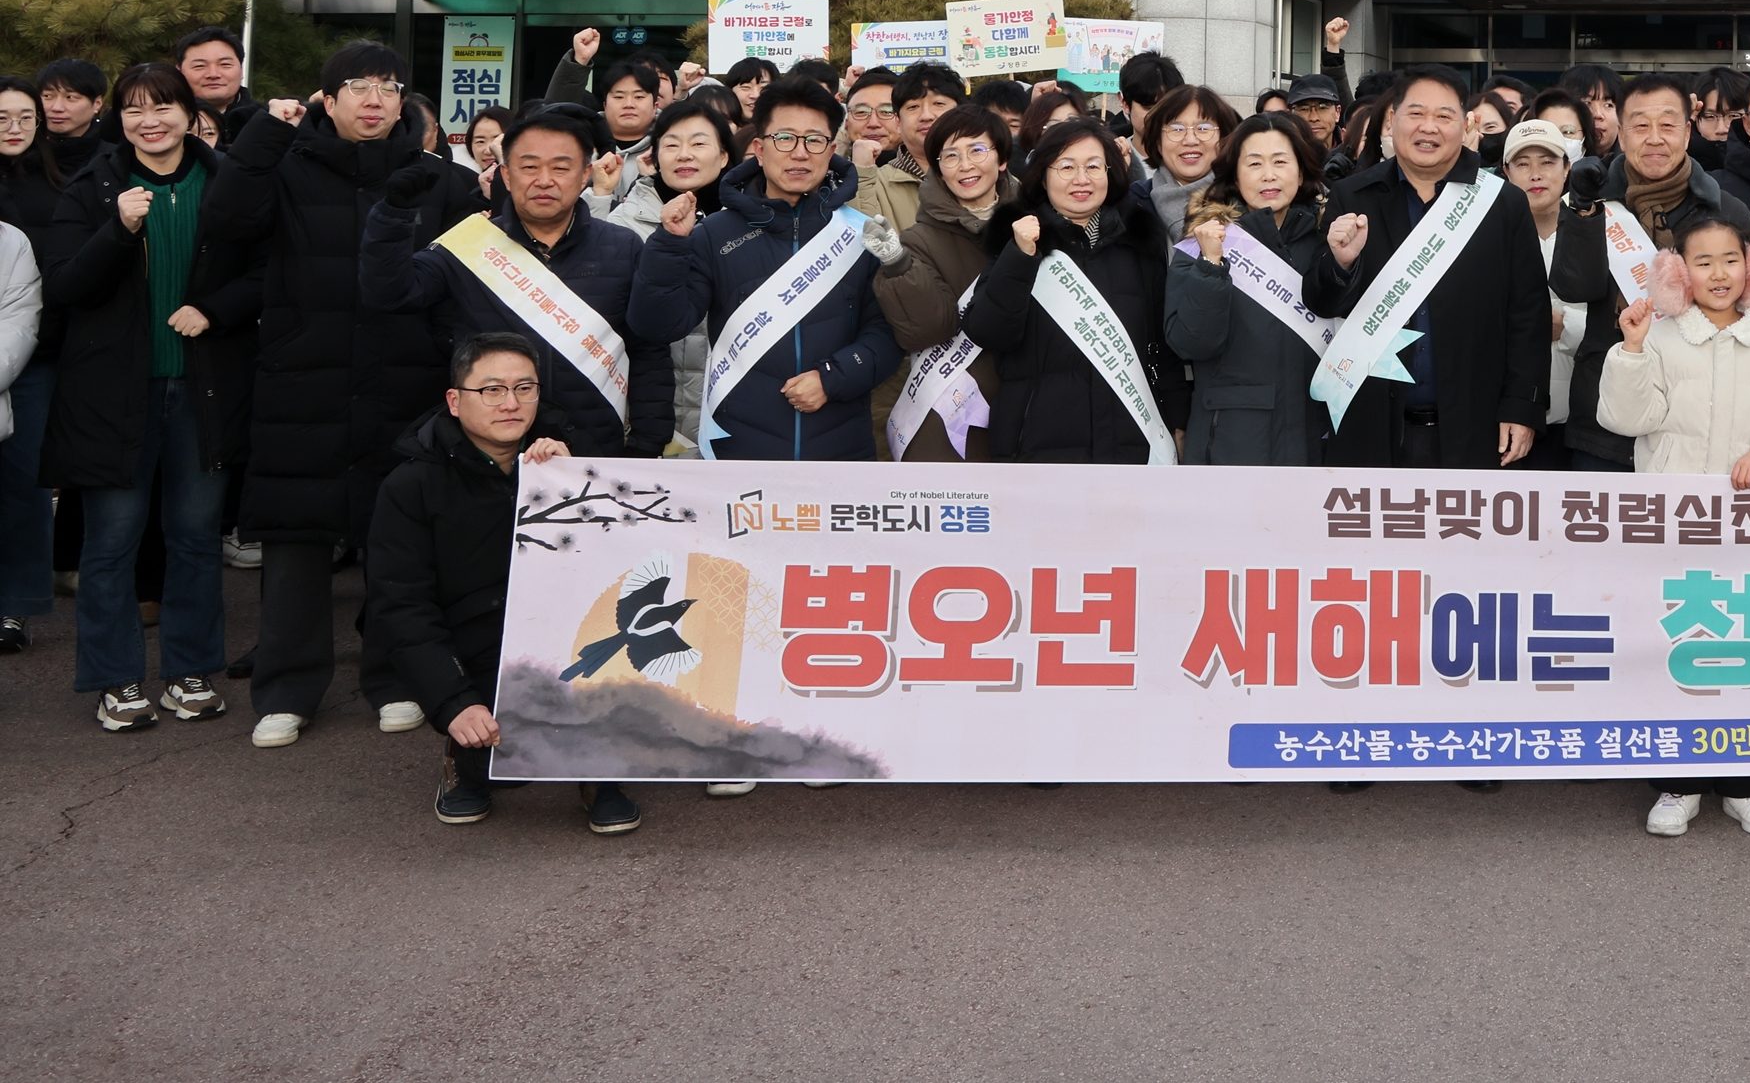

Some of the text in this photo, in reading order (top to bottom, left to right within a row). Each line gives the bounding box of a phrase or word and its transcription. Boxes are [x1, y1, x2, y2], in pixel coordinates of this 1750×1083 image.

[724, 16, 813, 28] 바가지요금 근절로
[984, 10, 1034, 25] 물가안정
[992, 27, 1029, 40] 다함께
[743, 31, 795, 42] 물가안정에
[746, 45, 792, 57] 동참합시다
[889, 48, 926, 56] 바가지요금
[984, 45, 1040, 59] 동참합시다!
[452, 69, 501, 94] 점심
[1606, 221, 1643, 253] 절약,
[483, 247, 531, 292] 살맛나는
[528, 287, 581, 334] 전통시장
[778, 253, 832, 306] 장흥에서
[1225, 249, 1316, 324] 바가지 요금 NO
[1049, 260, 1134, 367] 착한가격 착한업소
[1362, 277, 1412, 336] 생활안정
[728, 311, 773, 361] 살아나는
[1074, 317, 1151, 425] 살맛나는 지역경제
[890, 491, 989, 500] City of Nobel Literature
[772, 504, 990, 533] 노벨 문학도시 장흥
[1323, 487, 1541, 541] 설날맞이
[779, 563, 1138, 695] 병오년
[1180, 567, 1616, 692] 새해에는
[1274, 728, 1586, 762] 농수산물·농수산가공품
[1596, 724, 1683, 760] 설선물
